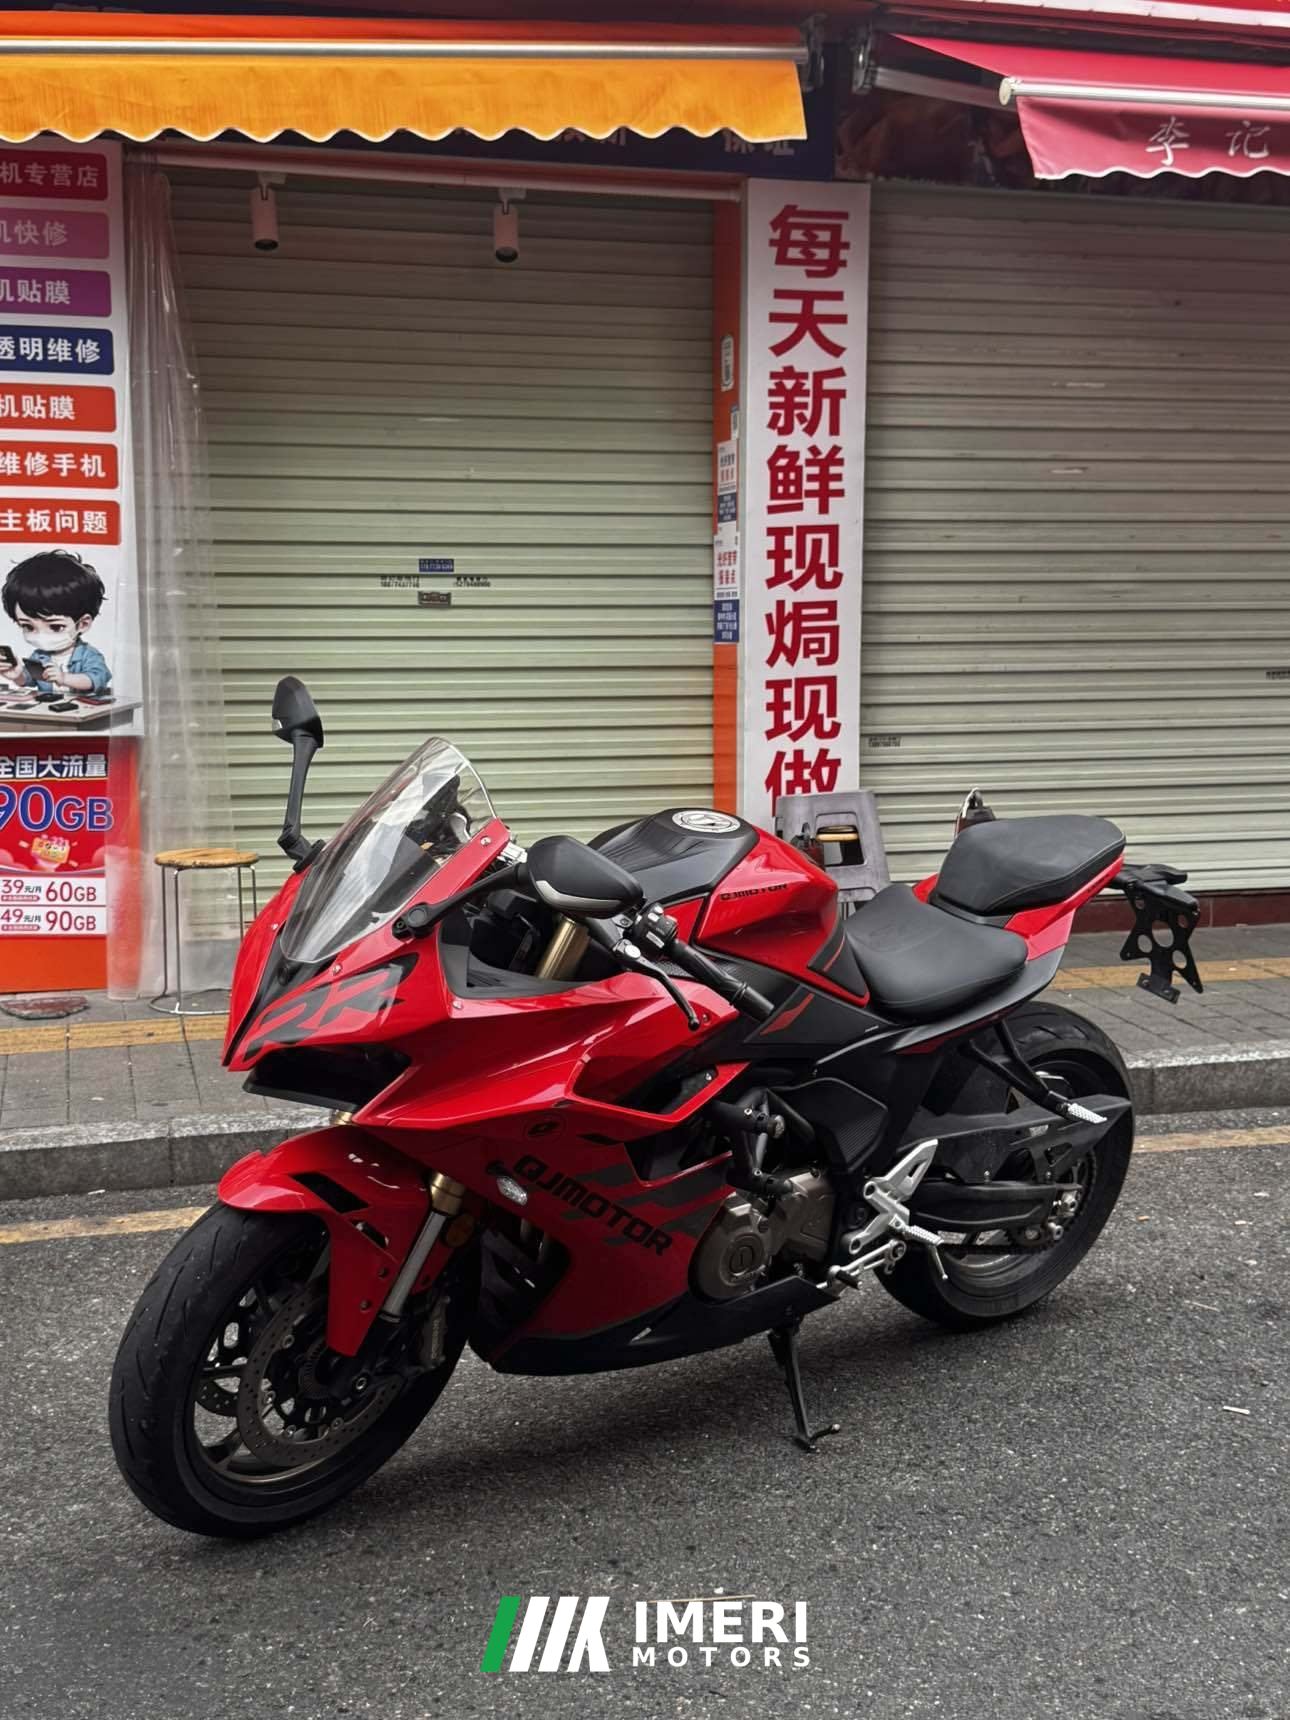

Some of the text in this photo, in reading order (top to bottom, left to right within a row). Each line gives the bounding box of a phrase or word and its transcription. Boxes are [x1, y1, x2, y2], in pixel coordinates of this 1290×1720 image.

[0, 161, 99, 188] 机专营店
[0, 336, 100, 364] 透明维修
[0, 452, 106, 478] 维修手机
[0, 508, 108, 534] 主板问题
[765, 204, 851, 817] 每天新鲜现焗现做
[46, 881, 96, 902] 60GB
[46, 910, 96, 931] 90GB
[513, 1155, 673, 1256] QJMOTOR
